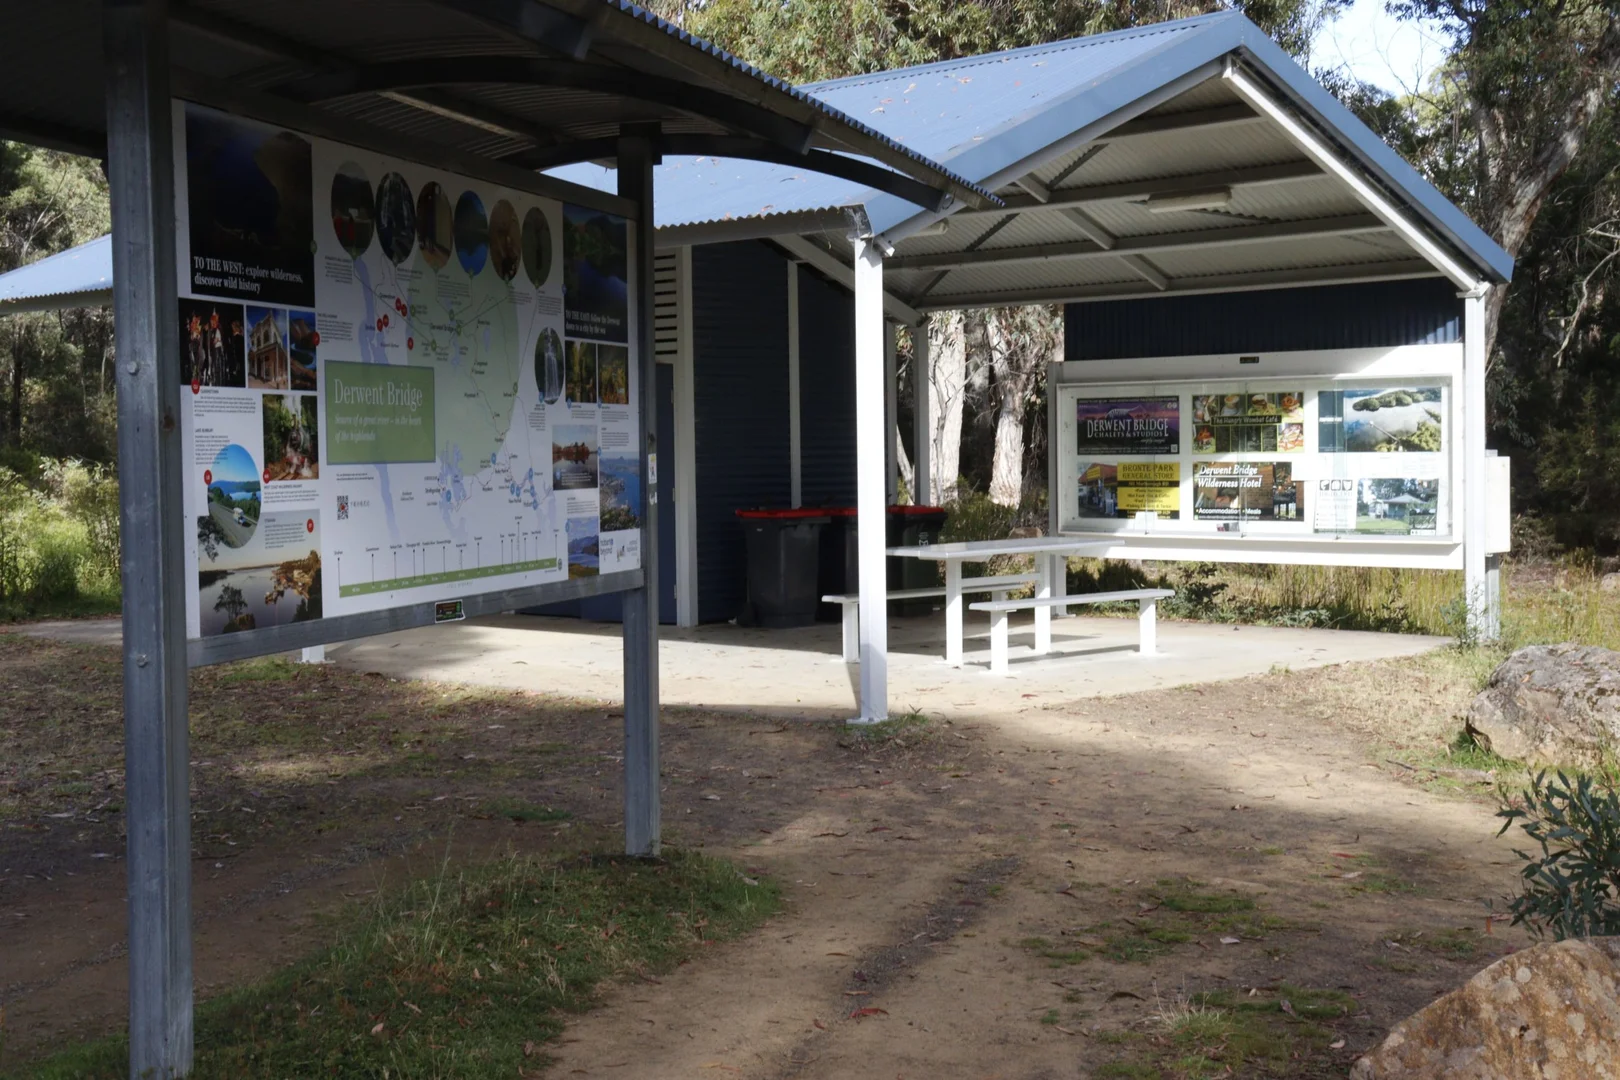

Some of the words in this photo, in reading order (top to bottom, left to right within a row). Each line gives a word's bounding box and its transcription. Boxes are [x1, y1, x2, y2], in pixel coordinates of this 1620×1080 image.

[194, 256, 204, 269] TO
[206, 258, 221, 272] THE
[222, 260, 244, 276] WEST:
[245, 265, 269, 279] explore
[194, 273, 222, 287] discover
[223, 276, 238, 289] wild
[238, 278, 261, 294] history
[334, 379, 384, 405] Derwent
[387, 382, 423, 412] Bridge
[1087, 419, 1132, 438] DERWENT
[1133, 419, 1168, 437] BRIDGE
[1200, 465, 1231, 475] Derwent
[1233, 464, 1258, 476] Bridge
[1199, 478, 1238, 488] Wilderness
[1240, 478, 1261, 487] Hotel
